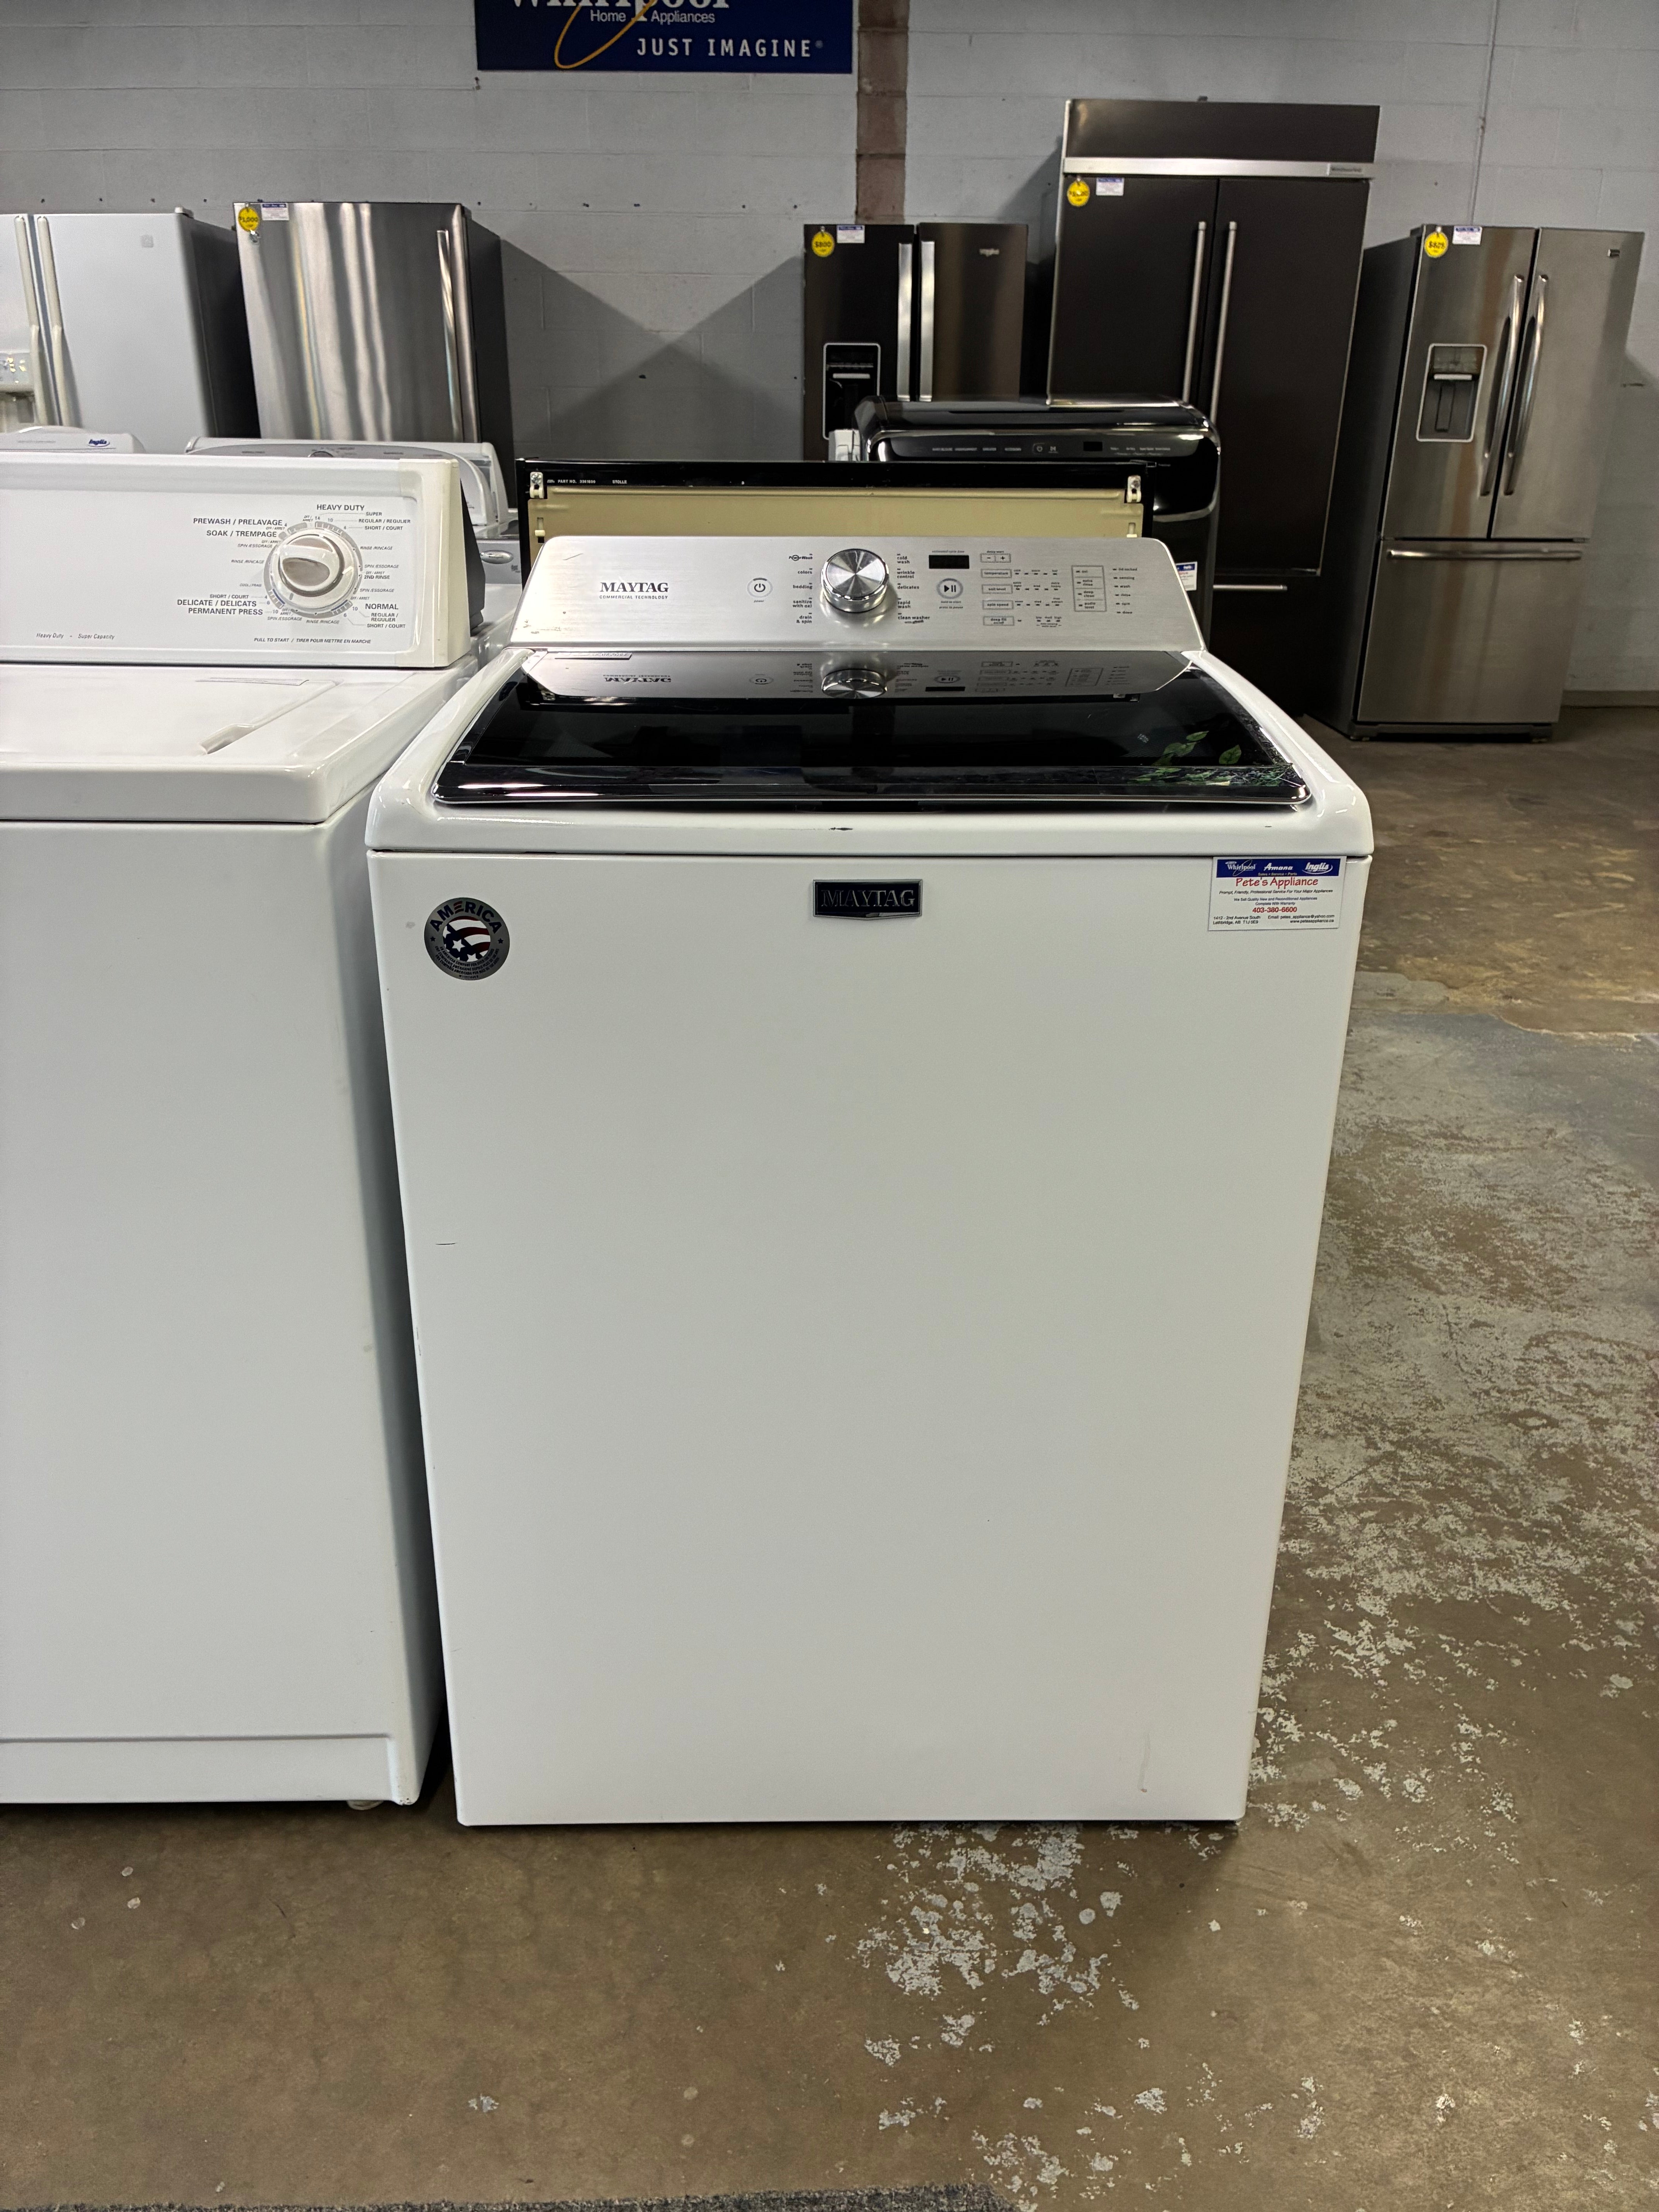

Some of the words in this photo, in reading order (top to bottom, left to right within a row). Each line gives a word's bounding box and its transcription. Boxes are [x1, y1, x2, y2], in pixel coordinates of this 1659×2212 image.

[591, 10, 626, 22] Home
[651, 10, 715, 25] Appliances
[637, 38, 692, 55] JUST
[708, 39, 810, 57] IMAGINE
[599, 582, 669, 592] MAYTAG
[1305, 862, 1329, 872] Inglis
[1236, 877, 1268, 886] Pete's
[1269, 876, 1318, 889] Appliance
[821, 890, 915, 907] MAYTAG
[430, 901, 502, 934] AMERICA
